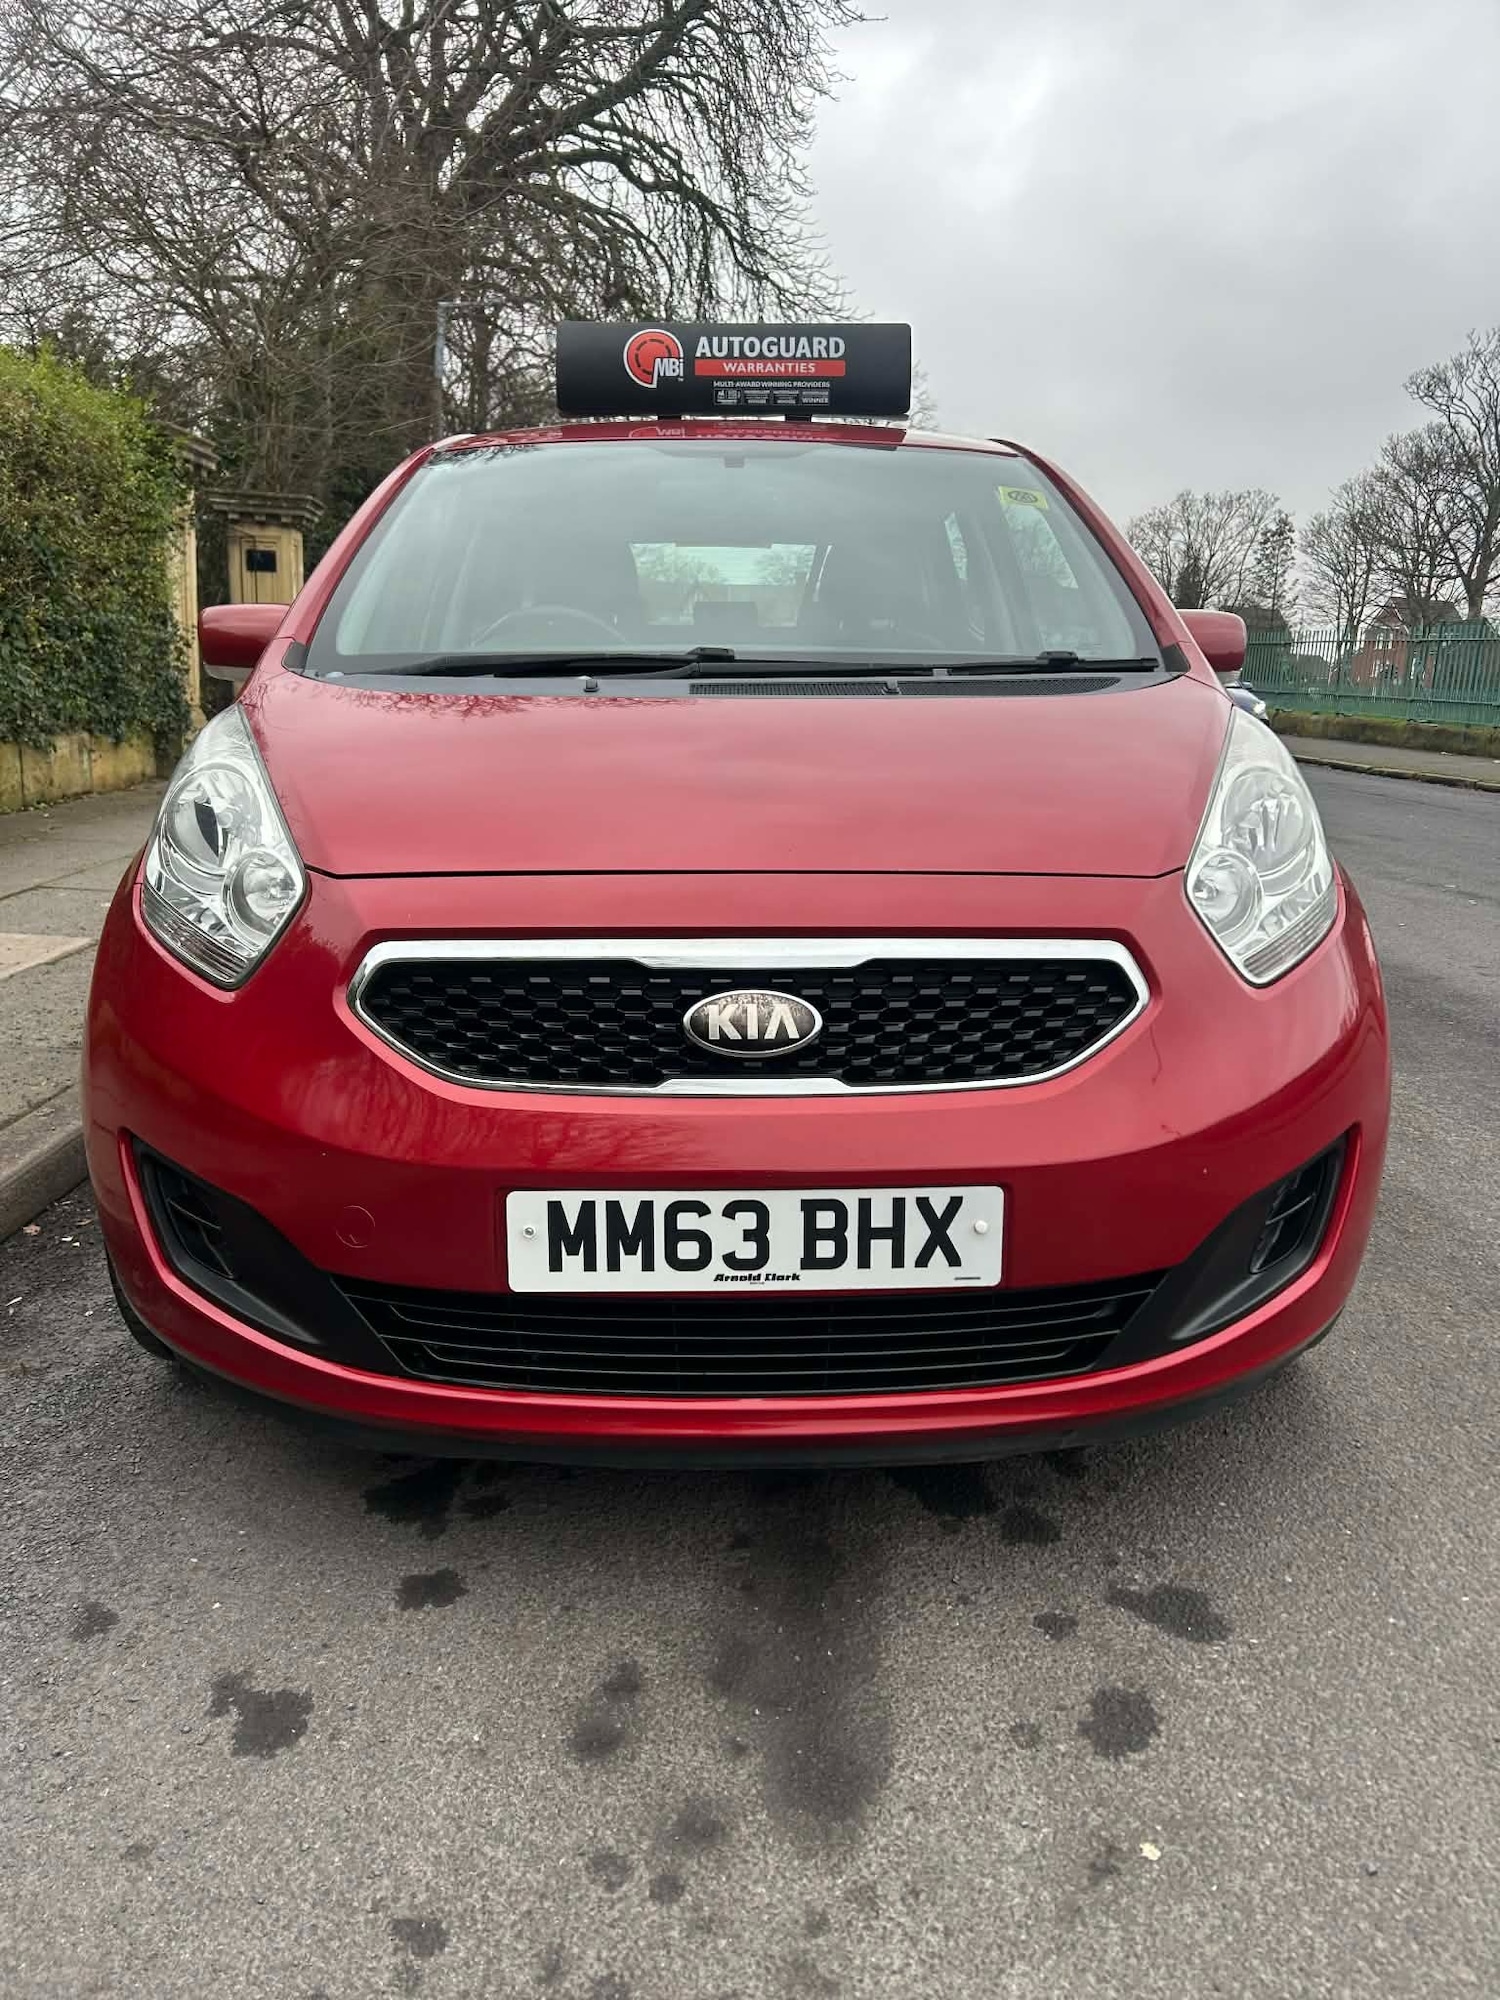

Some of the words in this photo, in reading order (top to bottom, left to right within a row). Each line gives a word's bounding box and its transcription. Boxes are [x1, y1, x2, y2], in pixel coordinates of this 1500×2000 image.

[695, 336, 845, 358] AUTOGUARD
[723, 362, 816, 373] WARRANTIES
[707, 1003, 800, 1040] KIA
[547, 1199, 770, 1272] MM63
[800, 1196, 964, 1269] BHX
[713, 1273, 762, 1282] Arnold
[764, 1273, 801, 1282] Clark
